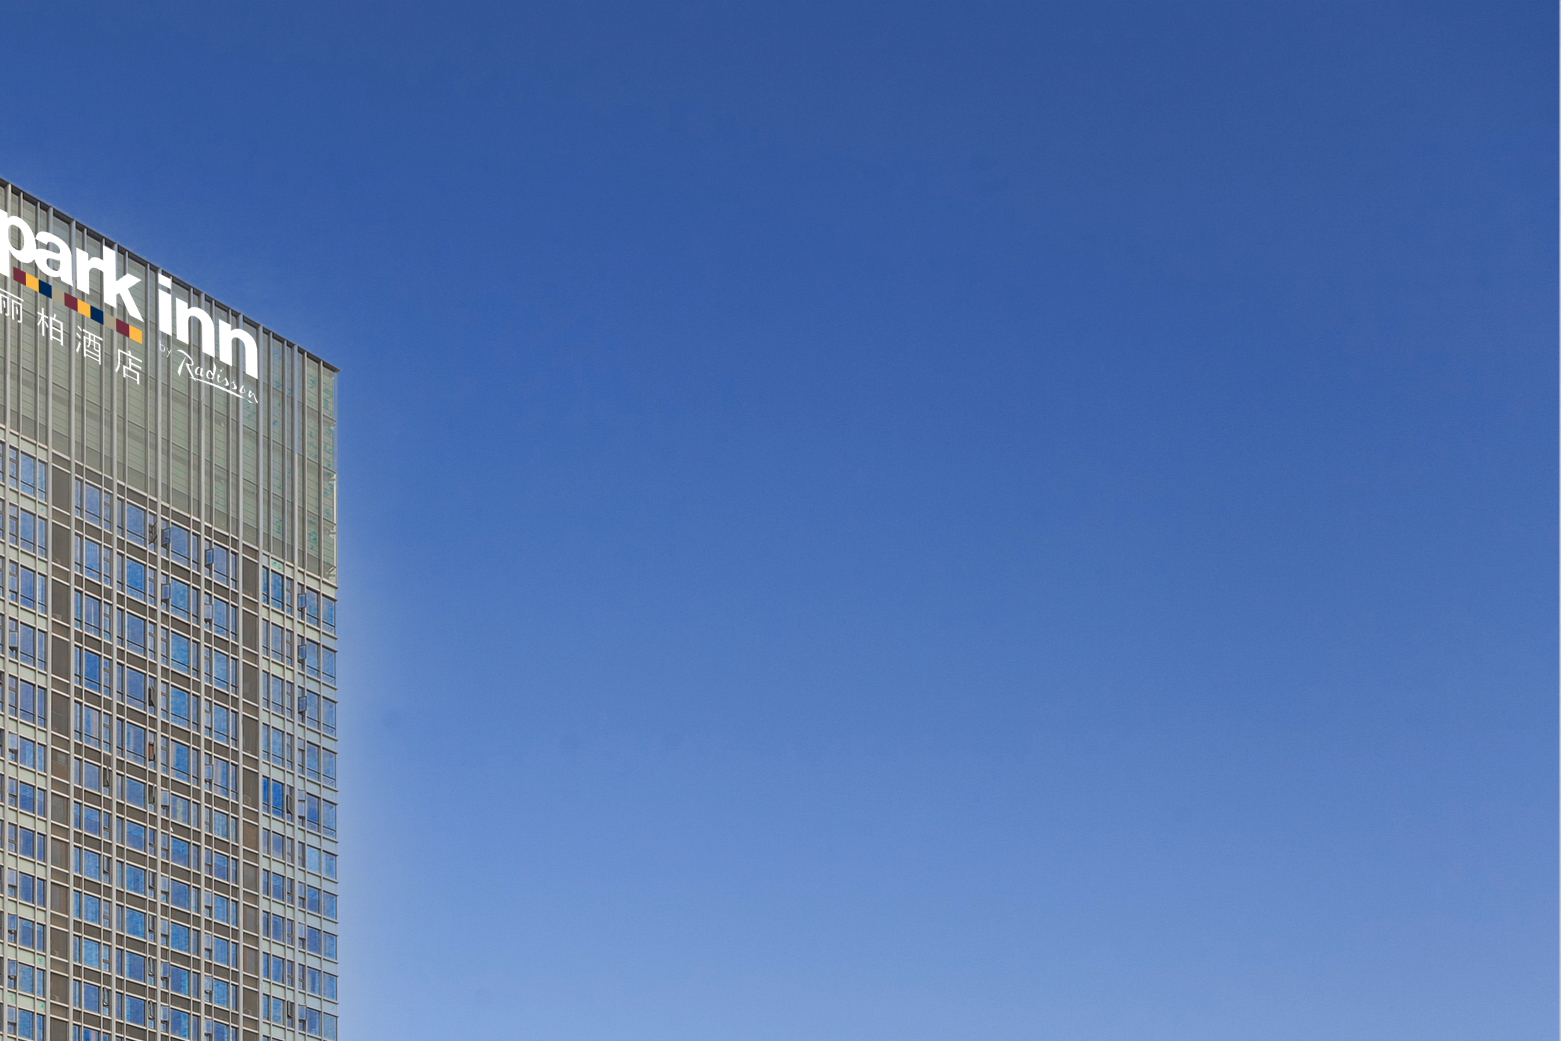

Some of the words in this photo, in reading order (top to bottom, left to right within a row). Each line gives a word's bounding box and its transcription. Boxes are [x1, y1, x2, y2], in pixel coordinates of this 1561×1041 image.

[158, 273, 259, 380] inn
[159, 343, 172, 358] by
[176, 349, 259, 404] Radisson
